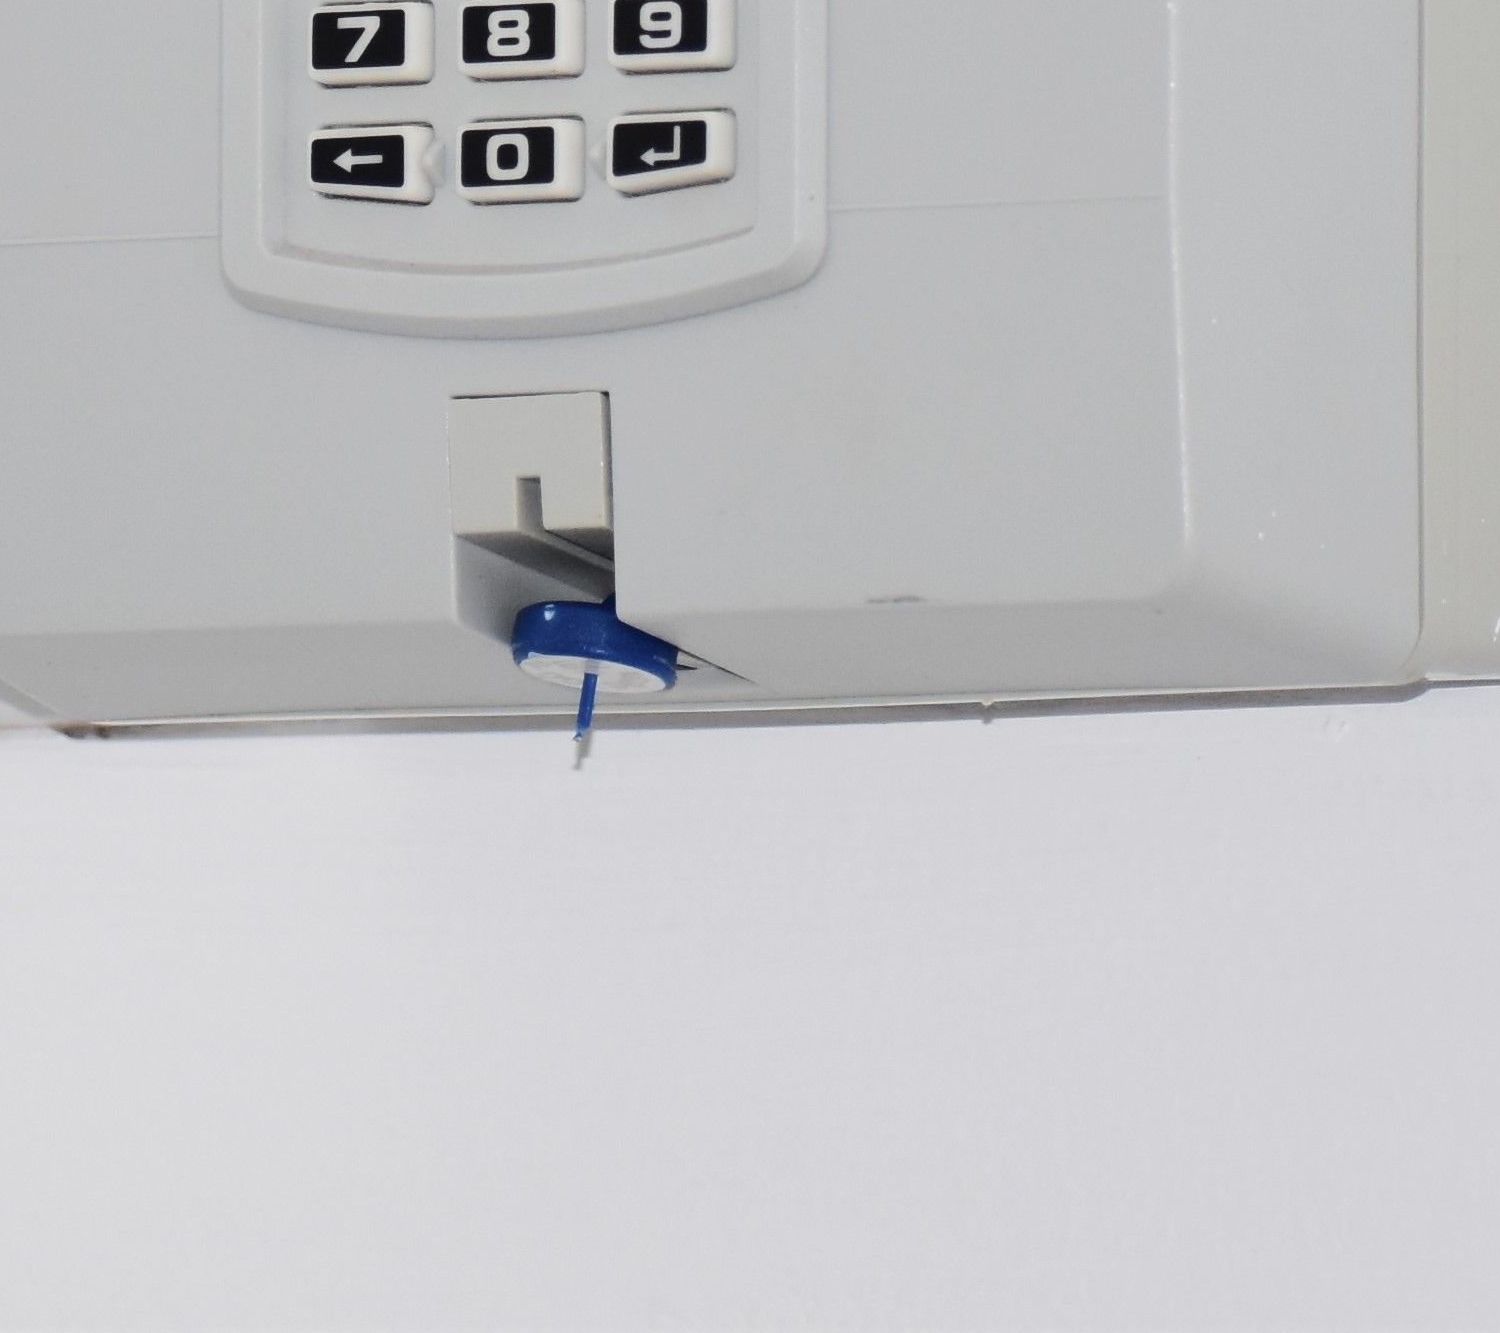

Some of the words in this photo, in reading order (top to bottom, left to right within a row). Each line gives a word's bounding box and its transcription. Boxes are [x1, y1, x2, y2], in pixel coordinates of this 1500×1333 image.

[336, 16, 381, 63] 7
[487, 9, 530, 57] 8
[639, 1, 682, 49] 9
[486, 133, 529, 181] 0
